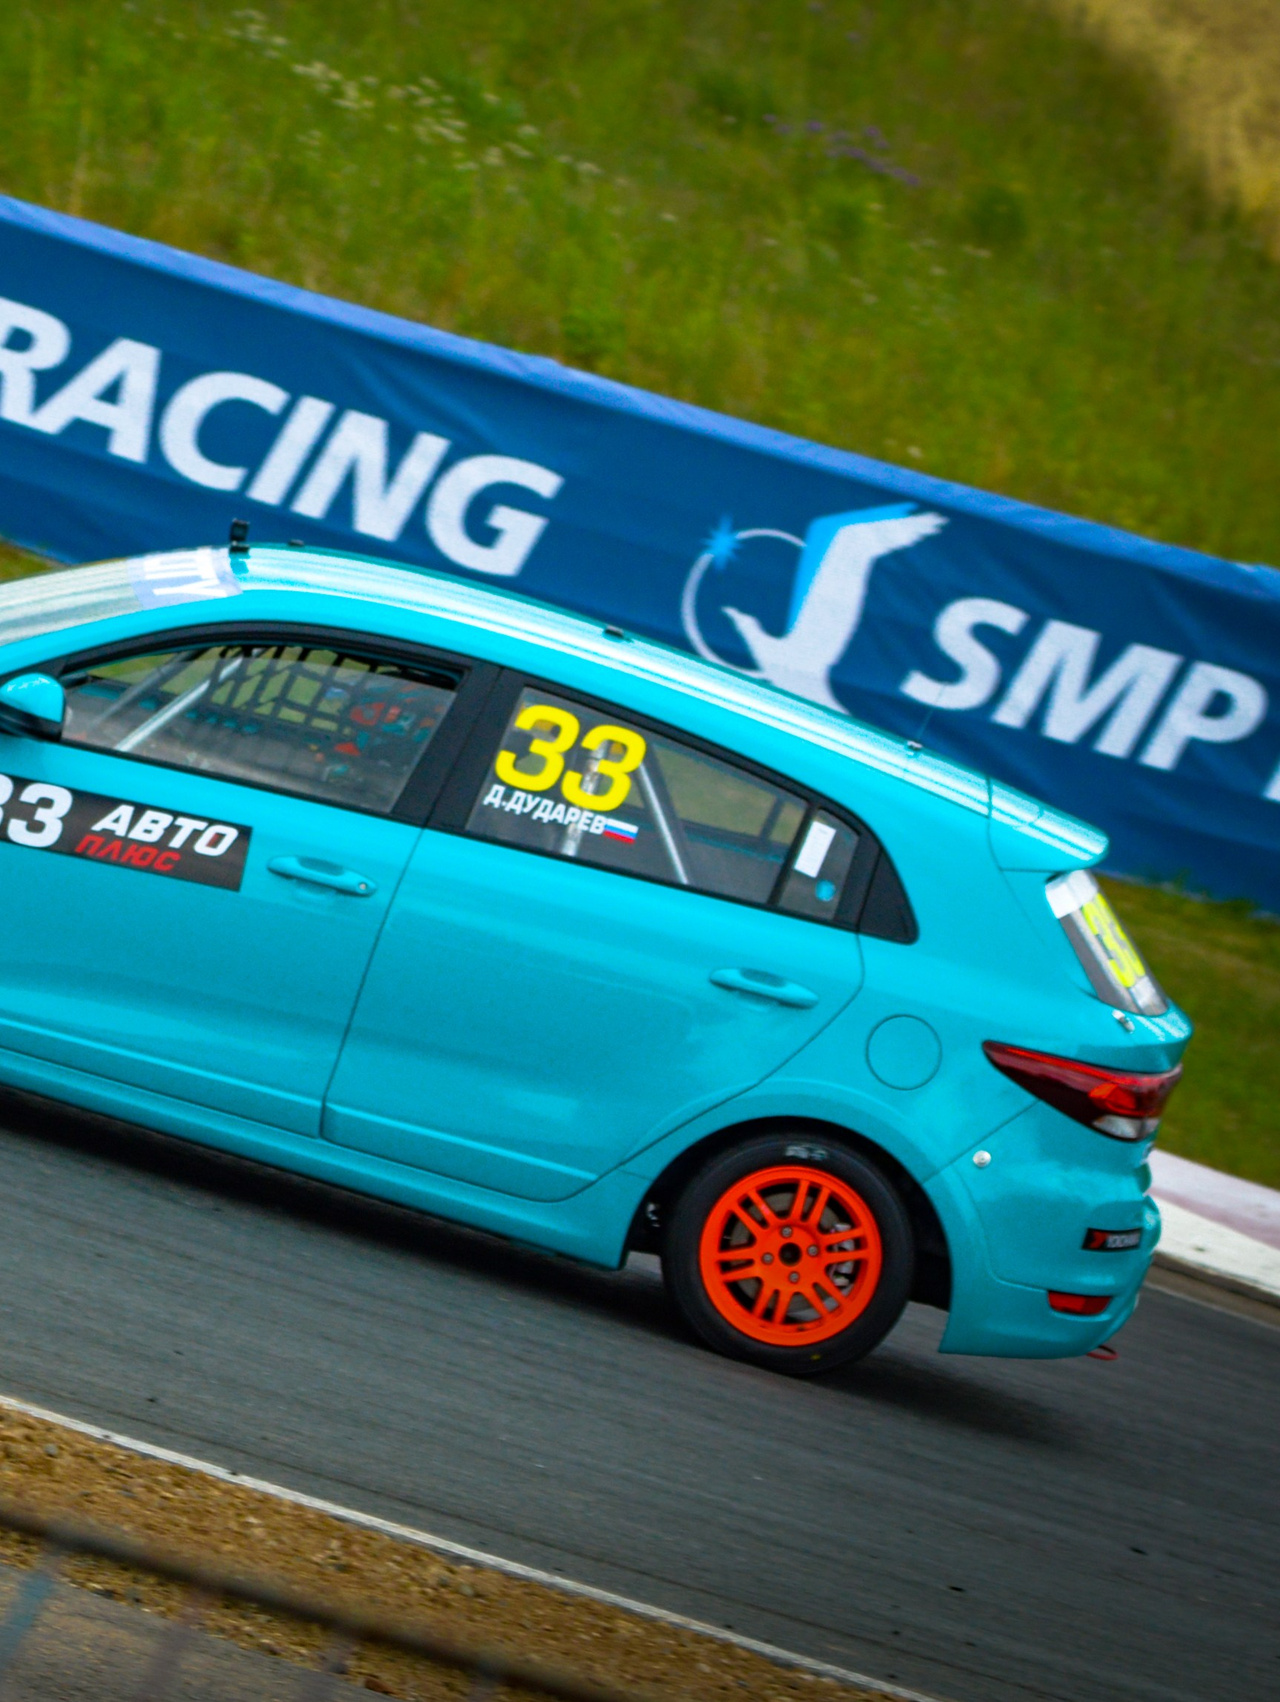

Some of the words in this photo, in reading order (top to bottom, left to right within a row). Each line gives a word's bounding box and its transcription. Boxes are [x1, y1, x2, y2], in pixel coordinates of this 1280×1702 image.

[899, 597, 1268, 771] SMP
[495, 704, 647, 812] 33
[91, 804, 239, 857] АВТО
[482, 784, 607, 836] Д.ДУДАРЕВ
[74, 834, 182, 872] ПЛЮС
